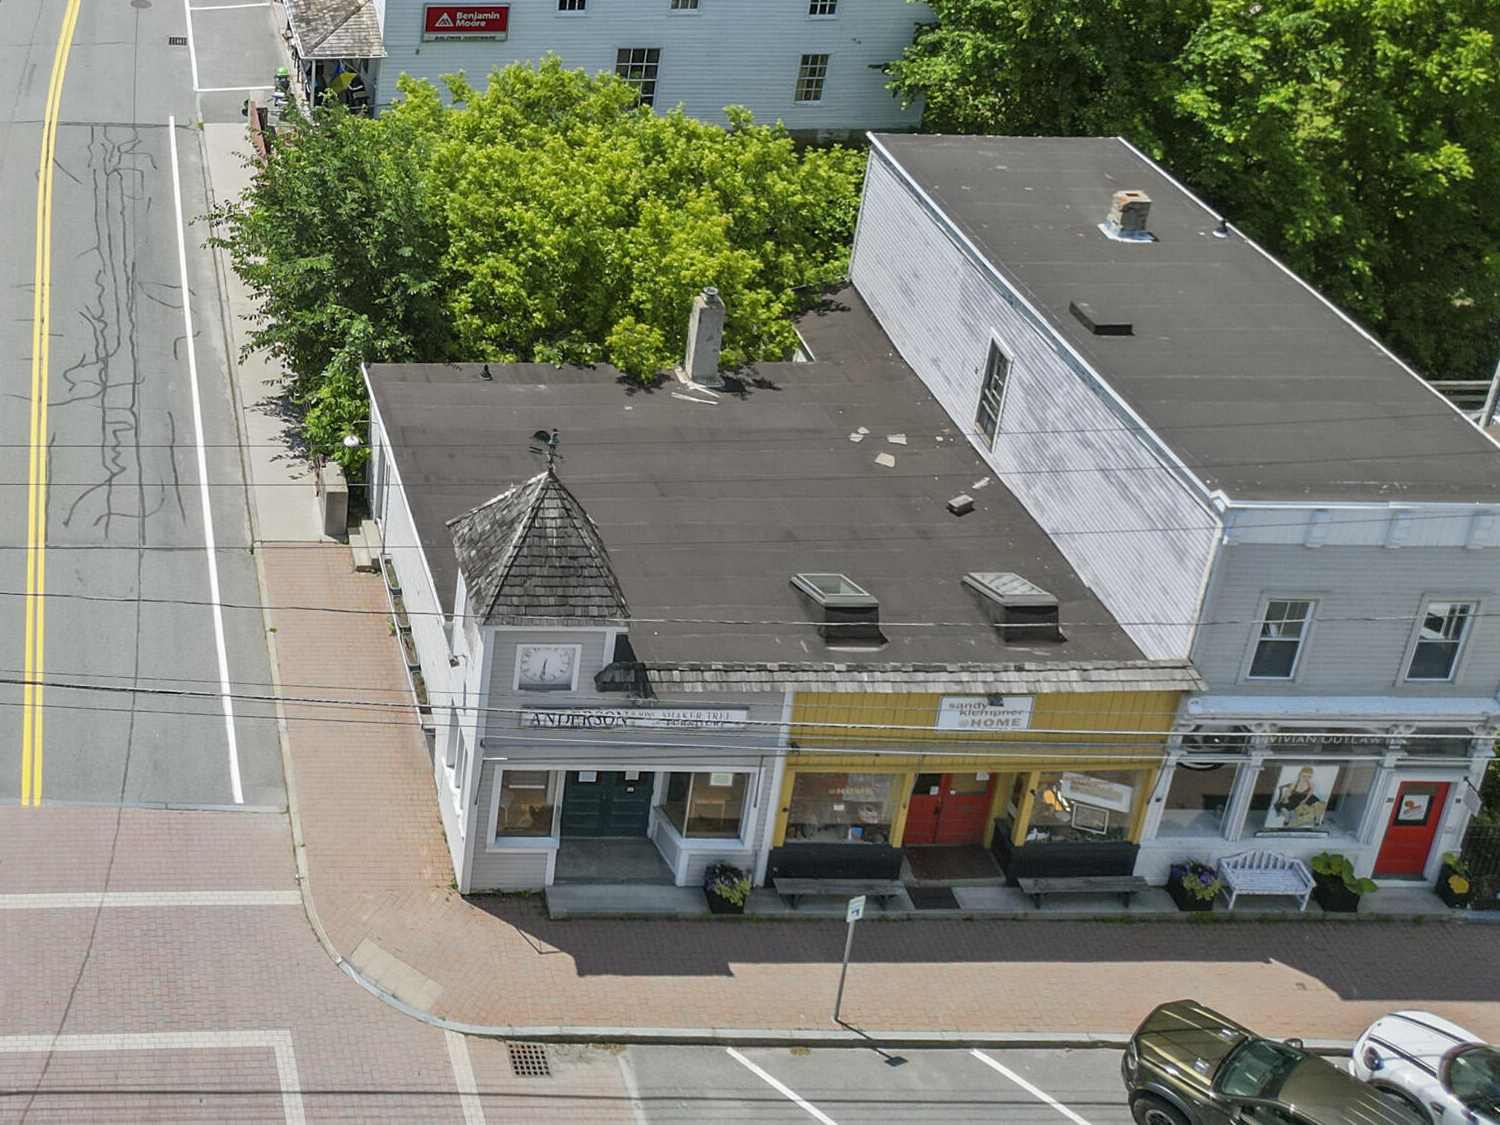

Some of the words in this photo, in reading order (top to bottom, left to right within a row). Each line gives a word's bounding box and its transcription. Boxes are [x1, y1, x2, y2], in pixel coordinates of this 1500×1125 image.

[456, 11, 500, 20] Benjamin
[948, 701, 988, 710] sandy
[959, 709, 1024, 717] klempner
[531, 711, 628, 726] ANDERSON
[1268, 735, 1317, 744] VIVIAN
[1321, 735, 1381, 745] OUTLAW
